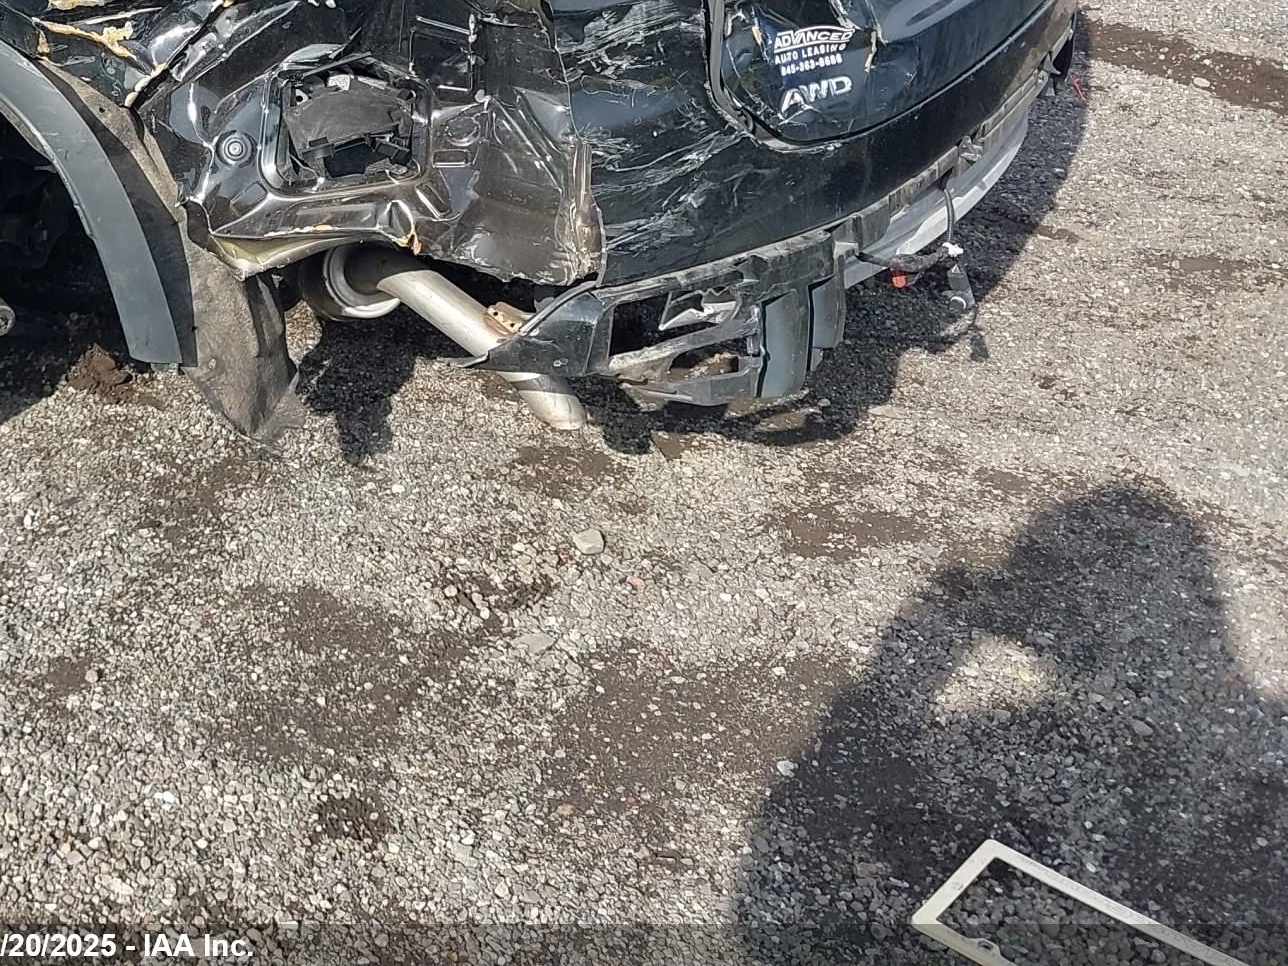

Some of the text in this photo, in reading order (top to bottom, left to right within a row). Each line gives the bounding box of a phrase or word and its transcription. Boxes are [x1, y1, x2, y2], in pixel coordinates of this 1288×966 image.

[774, 30, 853, 50] ADVANCED
[774, 42, 847, 65] AUTO LEASING
[780, 76, 853, 114] AWD
